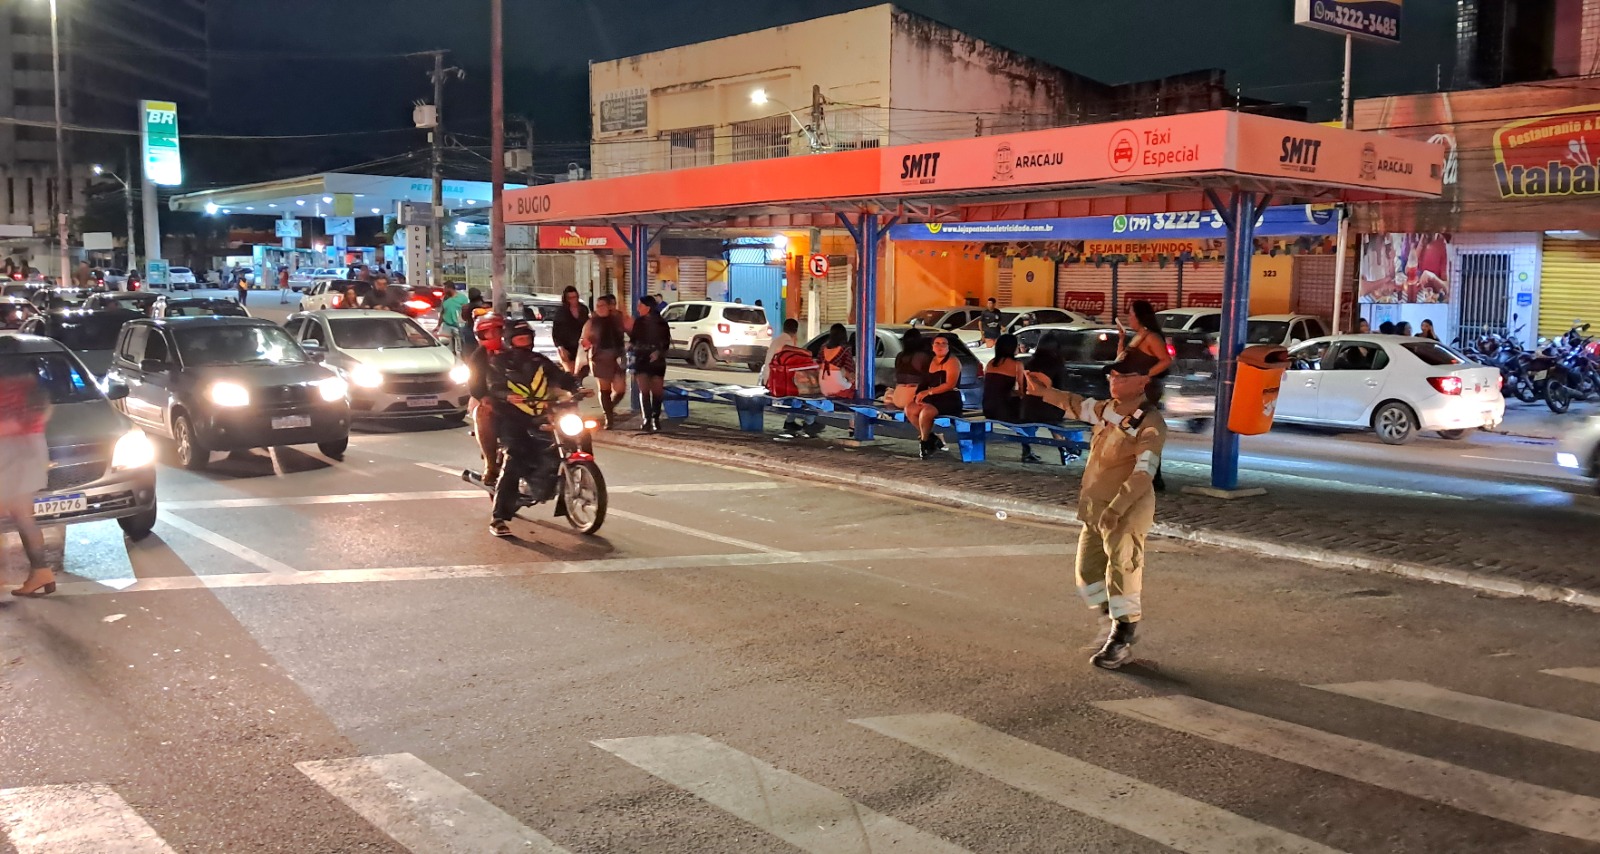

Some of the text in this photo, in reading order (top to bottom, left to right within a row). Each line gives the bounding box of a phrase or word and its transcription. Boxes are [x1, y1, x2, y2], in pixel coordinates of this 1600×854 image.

[1336, 5, 1397, 36] 3222-3485
[148, 110, 174, 125] BR
[1144, 128, 1171, 146] Táxi
[1508, 121, 1581, 148] Restaurante
[1583, 119, 1593, 131] &
[1143, 144, 1199, 168] Especial
[1279, 135, 1322, 166] SMTT
[900, 152, 940, 179] SMTT
[1015, 152, 1064, 169] ARACAJU
[1377, 159, 1414, 175] ARACAJU
[1492, 158, 1600, 199] Itaba
[517, 194, 551, 215] BUGIO
[1128, 215, 1150, 231] (79)
[1089, 242, 1193, 254] SEJAM BEM-VINDOS
[1263, 270, 1277, 278] 323
